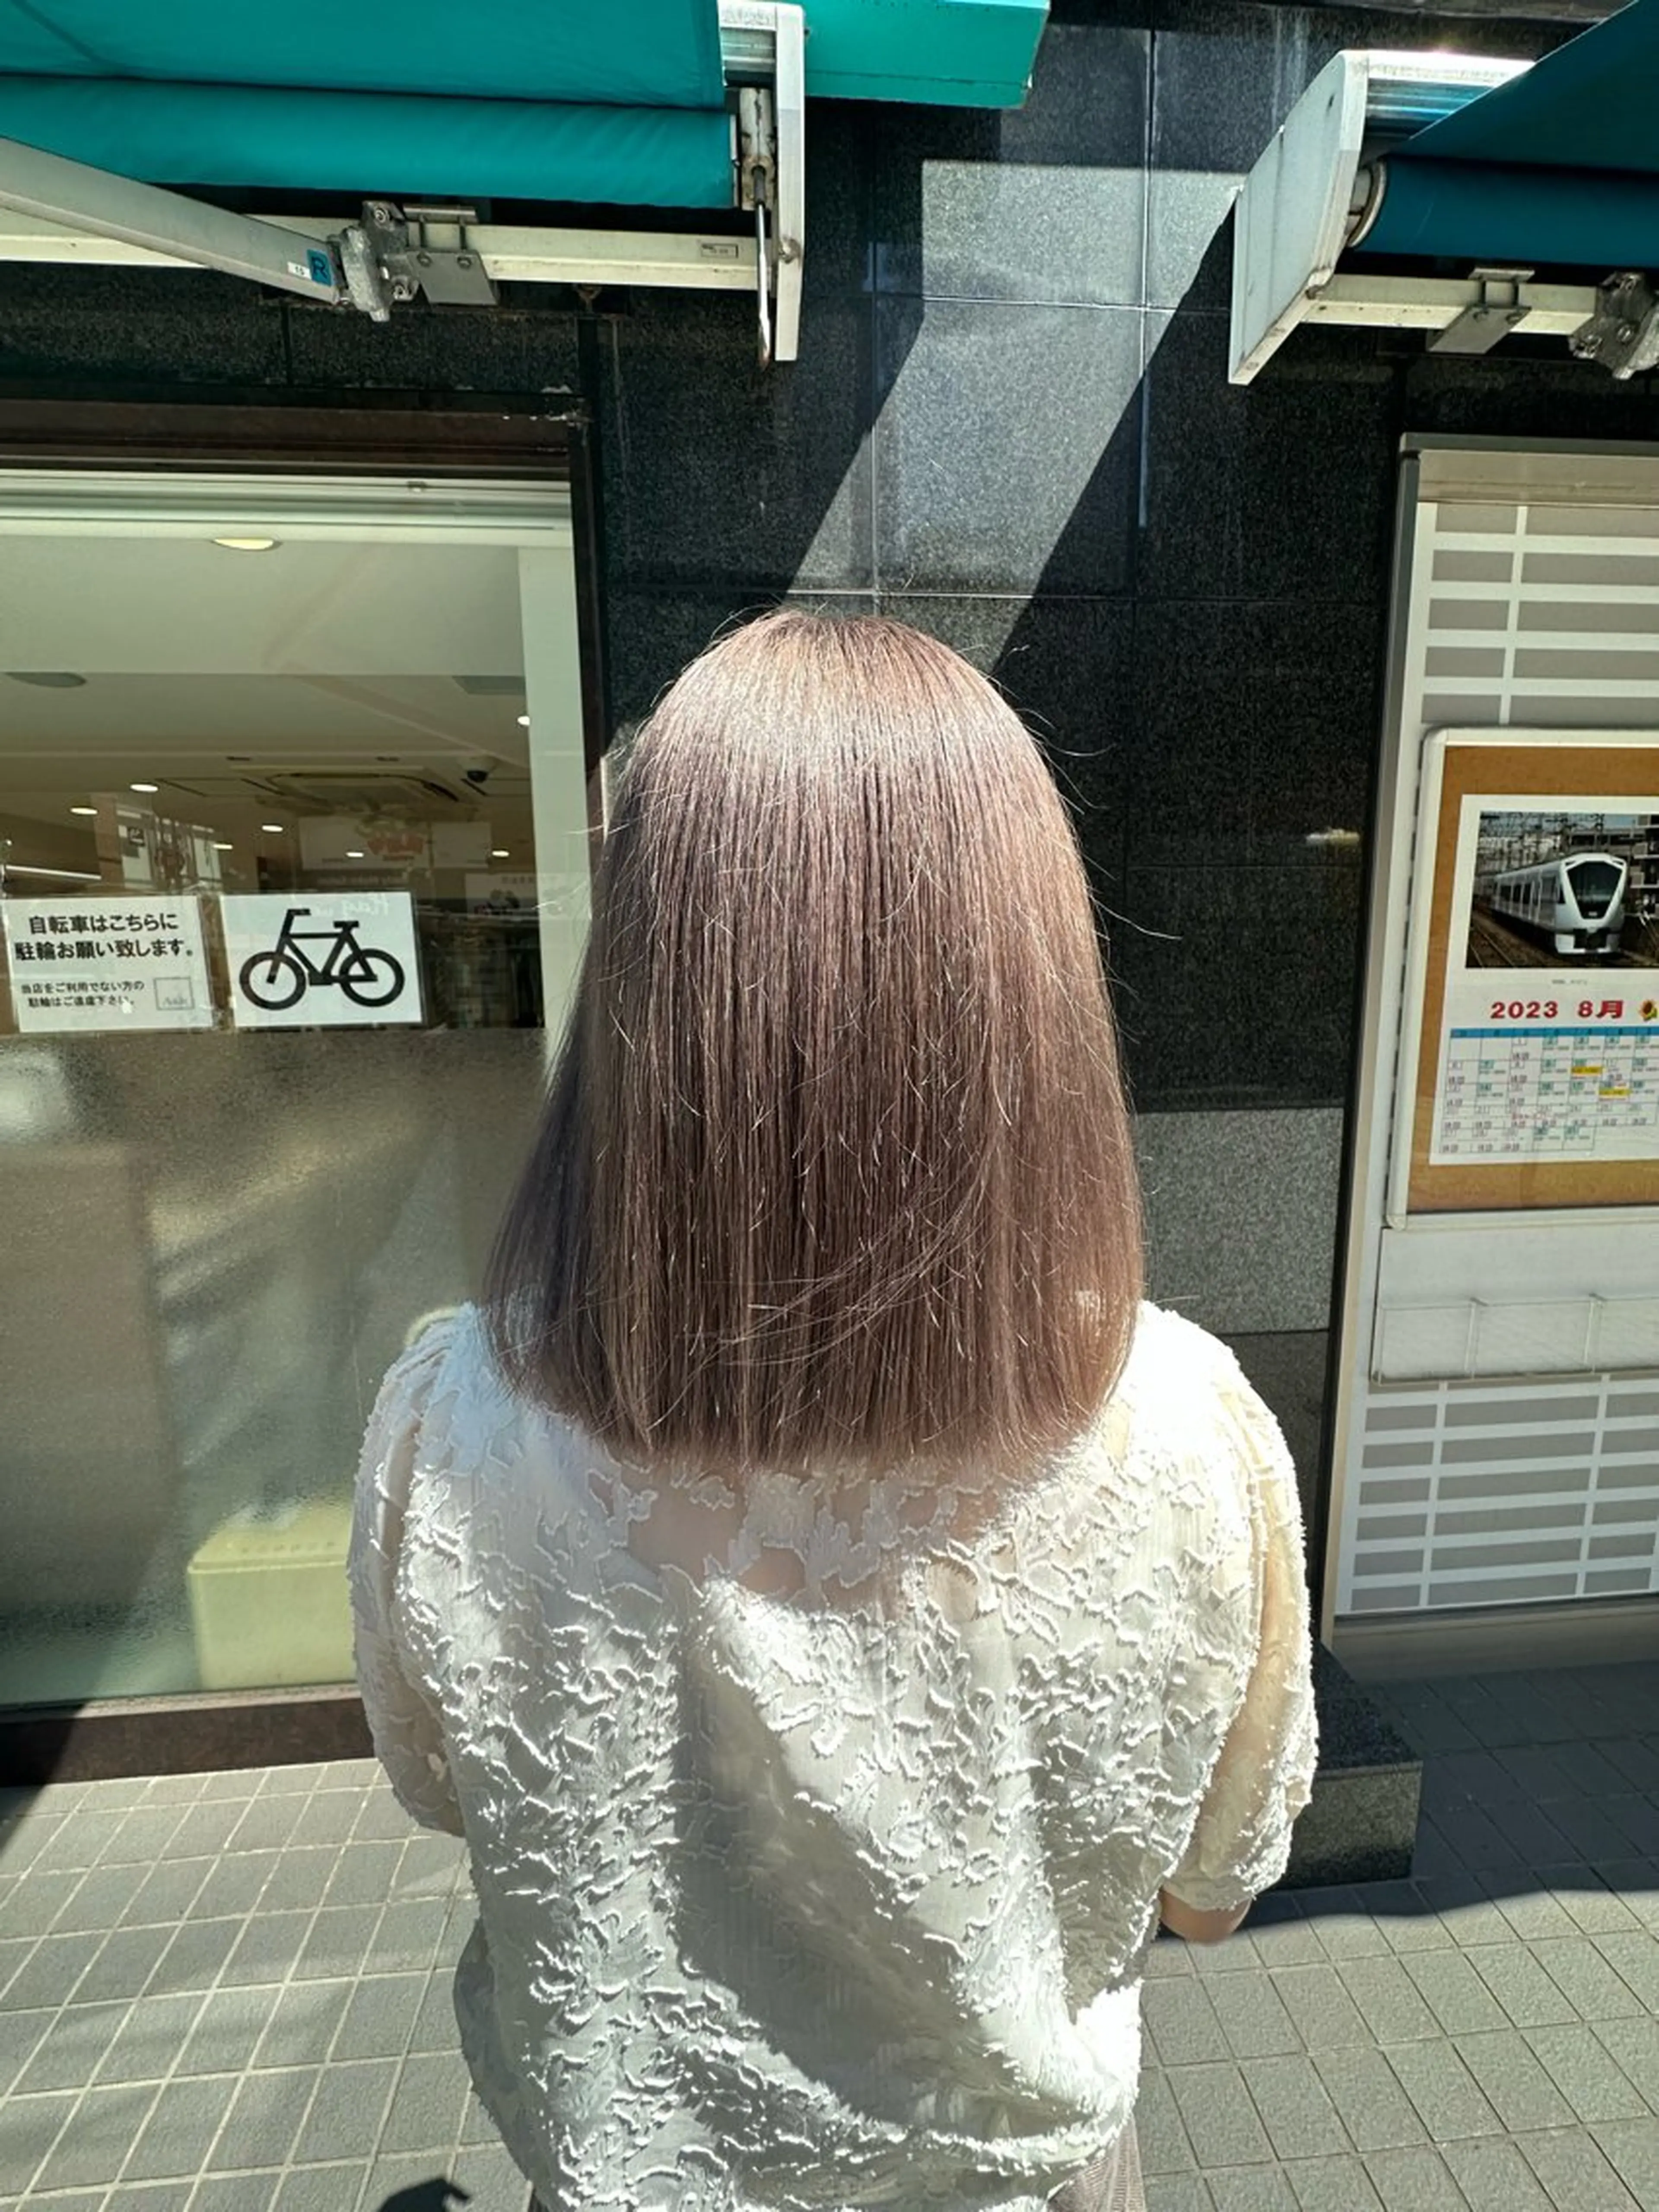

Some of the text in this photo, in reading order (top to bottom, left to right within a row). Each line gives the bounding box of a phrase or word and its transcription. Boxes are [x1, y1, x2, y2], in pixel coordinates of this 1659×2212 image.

[311, 256, 328, 280] R
[29, 913, 179, 934] 自転車はこちらに
[14, 938, 193, 960] 駐輪お願い致します。
[1490, 1001, 1558, 1019] 2023
[1578, 999, 1624, 1019] 8月
